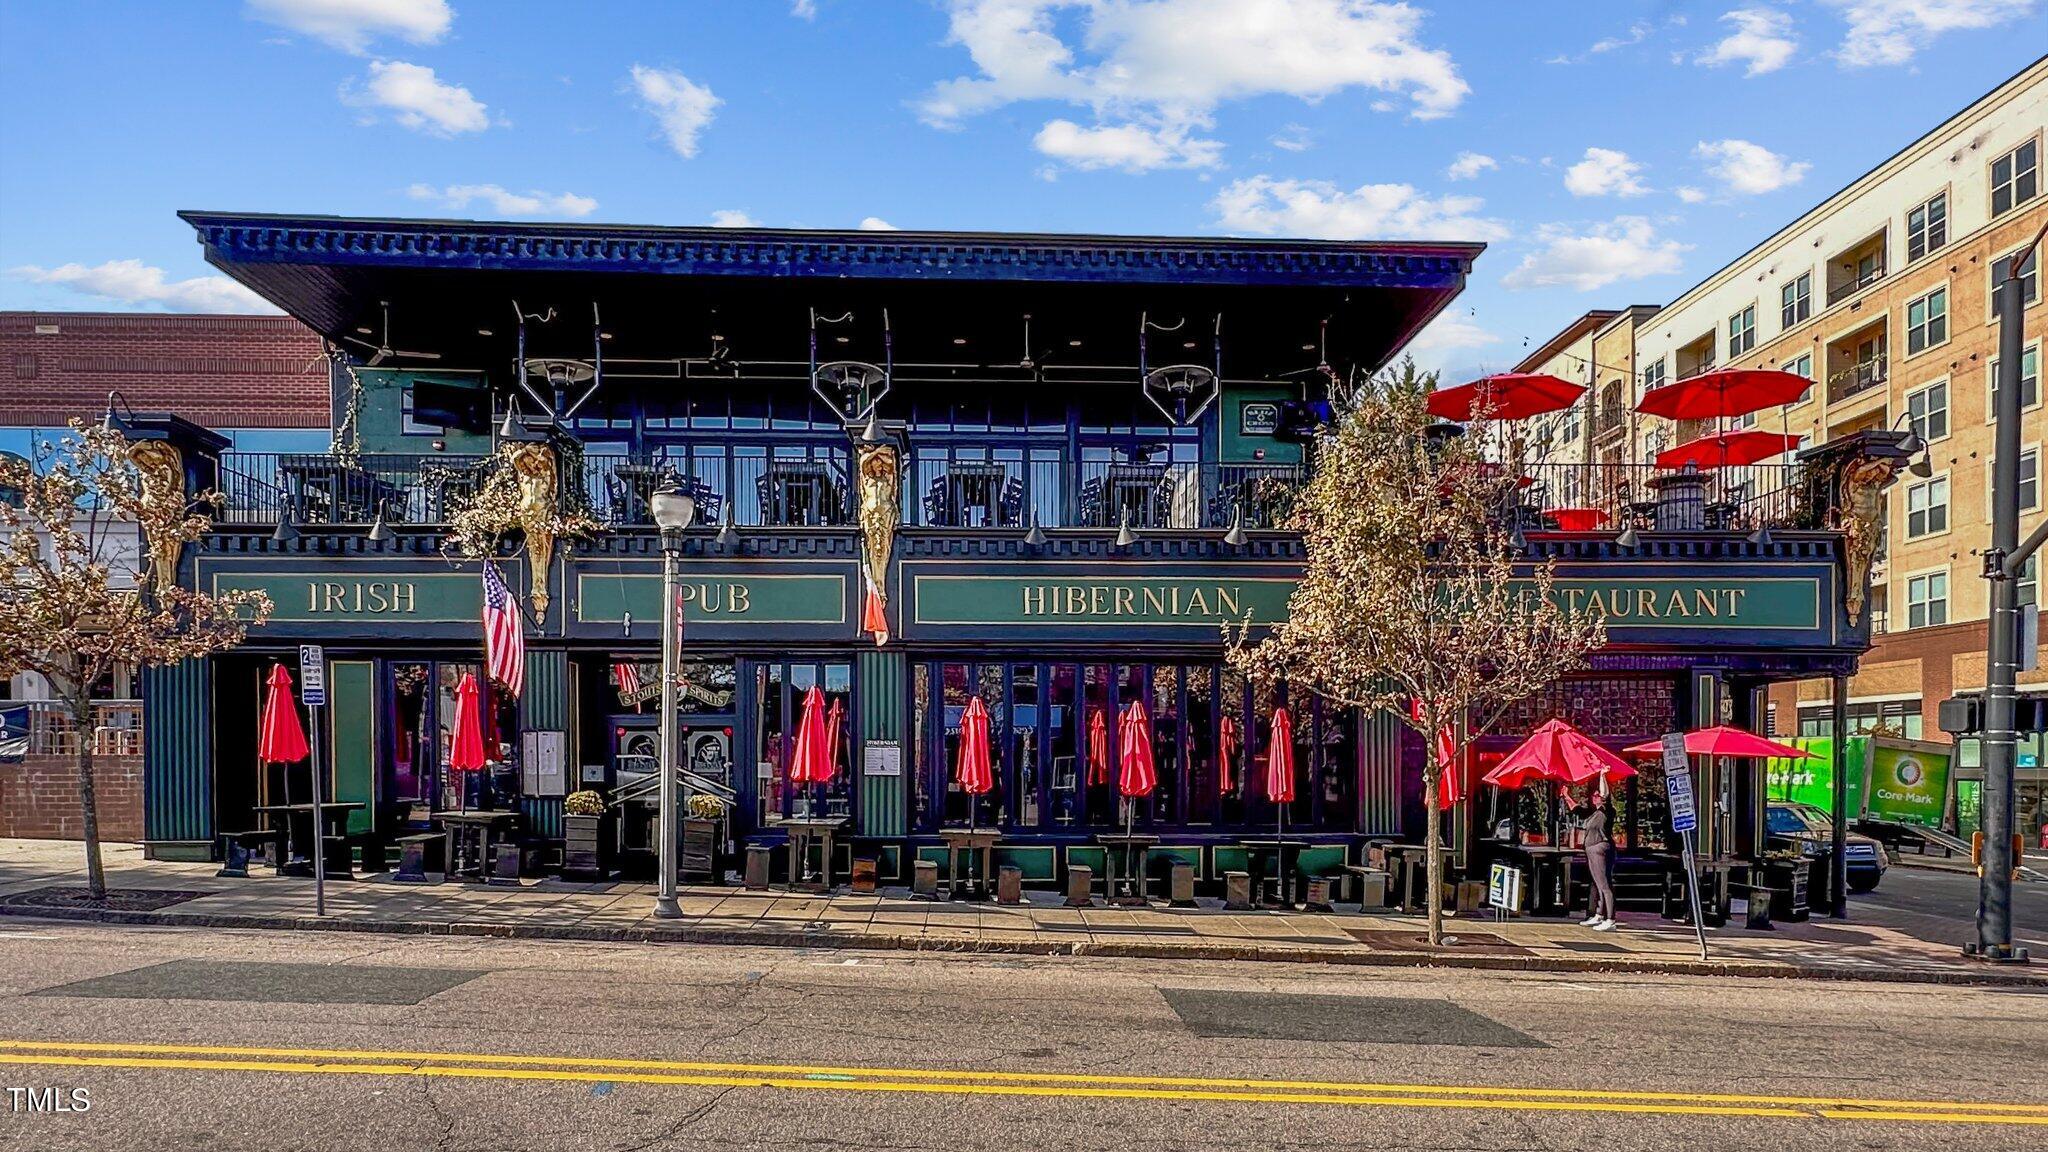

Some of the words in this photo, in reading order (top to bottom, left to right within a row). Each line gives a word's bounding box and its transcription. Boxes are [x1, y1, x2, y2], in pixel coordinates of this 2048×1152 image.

[308, 582, 416, 612] IRISH
[681, 584, 750, 613] PUB
[1022, 586, 1240, 615] HIBERNIAN
[302, 649, 309, 663] 2
[689, 685, 725, 705] SPIRITS
[1669, 780, 1678, 794] 2
[1876, 788, 1933, 805] Core-Mark
